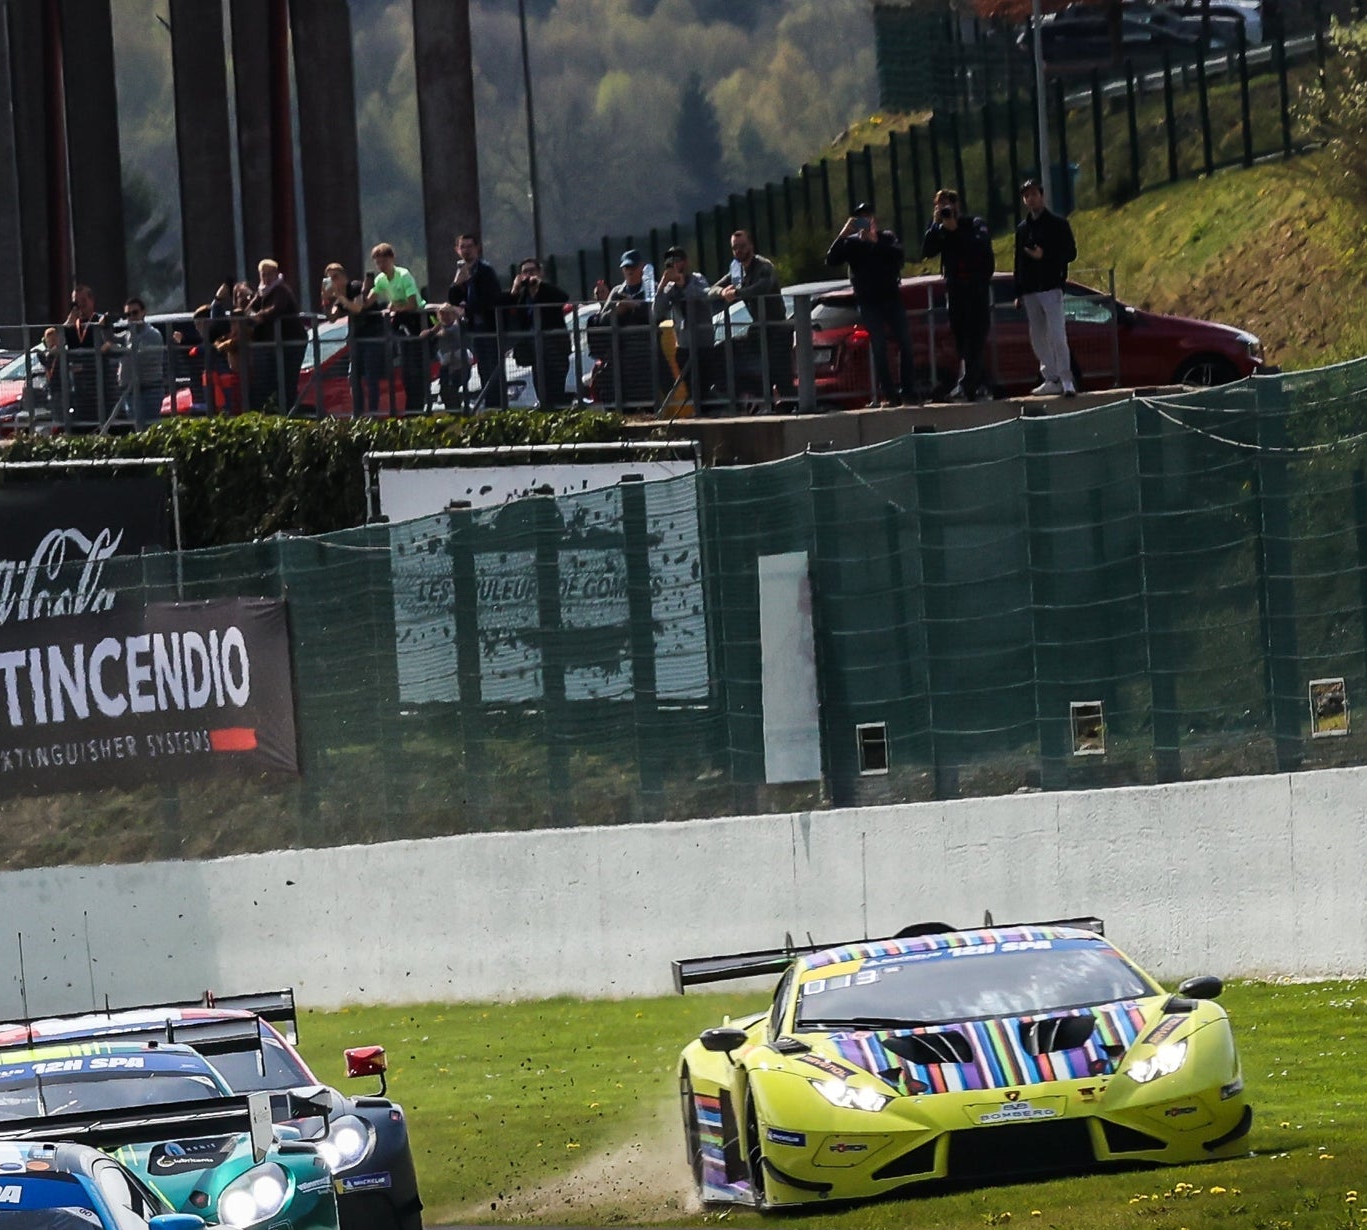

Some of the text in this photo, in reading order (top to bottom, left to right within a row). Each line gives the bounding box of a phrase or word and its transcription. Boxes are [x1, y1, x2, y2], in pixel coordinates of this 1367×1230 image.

[147, 730, 211, 758] SYSTEMS
[950, 943, 996, 956] 12H
[1000, 940, 1053, 951] SPA
[32, 1058, 84, 1074] 12H
[88, 1056, 146, 1070] SPA
[979, 1107, 1057, 1121] BOMBERG
